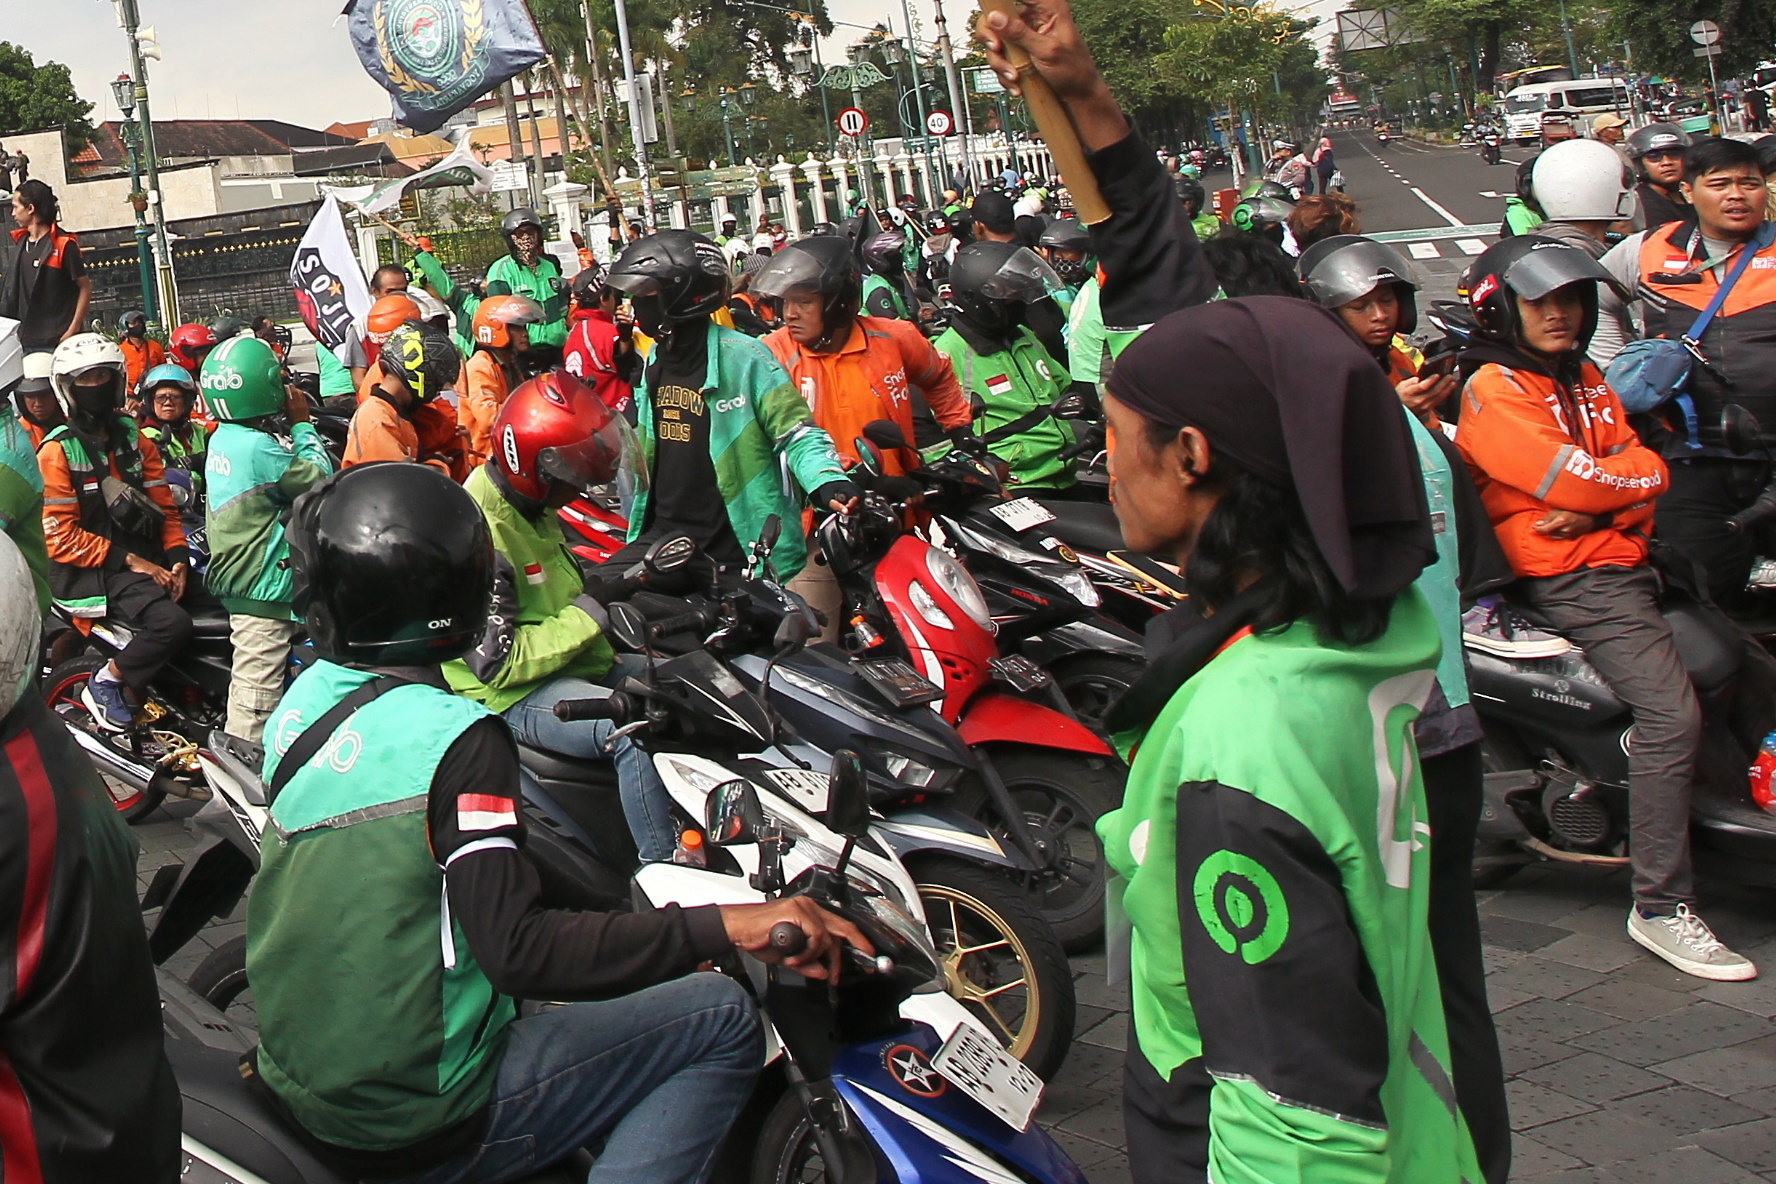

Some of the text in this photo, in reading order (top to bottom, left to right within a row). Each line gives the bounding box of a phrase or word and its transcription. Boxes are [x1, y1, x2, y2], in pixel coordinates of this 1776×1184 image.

[930, 117, 943, 129] 40
[200, 368, 244, 391] Grab
[773, 771, 802, 791] AB
[946, 1056, 983, 1094] AB
